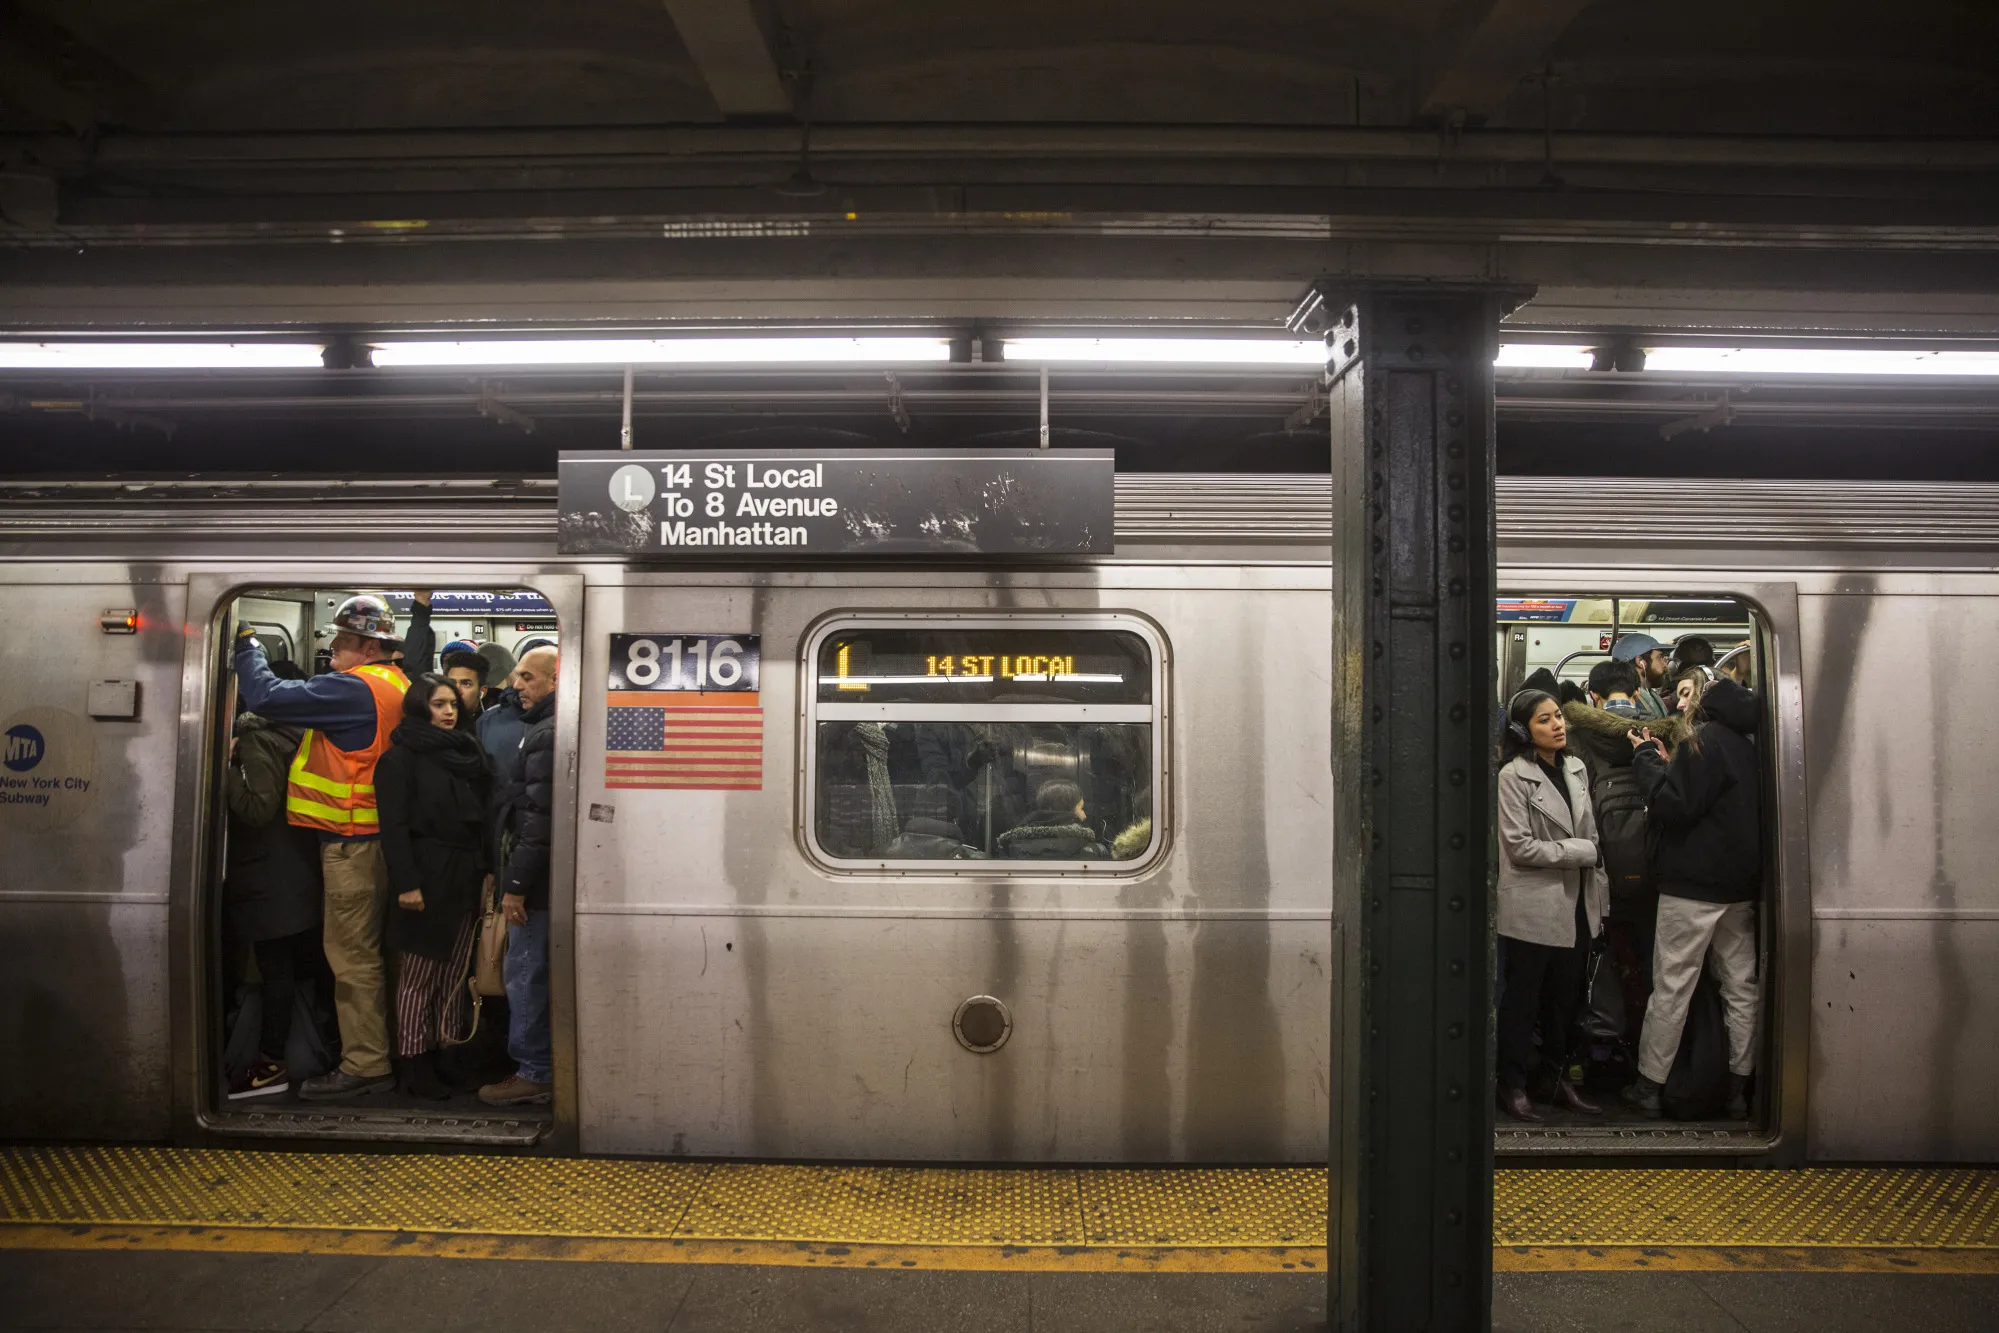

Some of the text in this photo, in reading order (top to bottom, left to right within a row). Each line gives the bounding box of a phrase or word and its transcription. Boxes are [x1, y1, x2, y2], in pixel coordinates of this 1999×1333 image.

[623, 475, 644, 501] L
[660, 463, 824, 489] 14 St Local
[660, 492, 839, 518] To 8 Avenue
[660, 521, 809, 546] Manhattan
[625, 638, 744, 687] 8116
[837, 642, 868, 690] L
[926, 655, 1079, 678] 14 ST LOCAL
[0, 776, 91, 793] New York City
[0, 791, 50, 808] Subway
